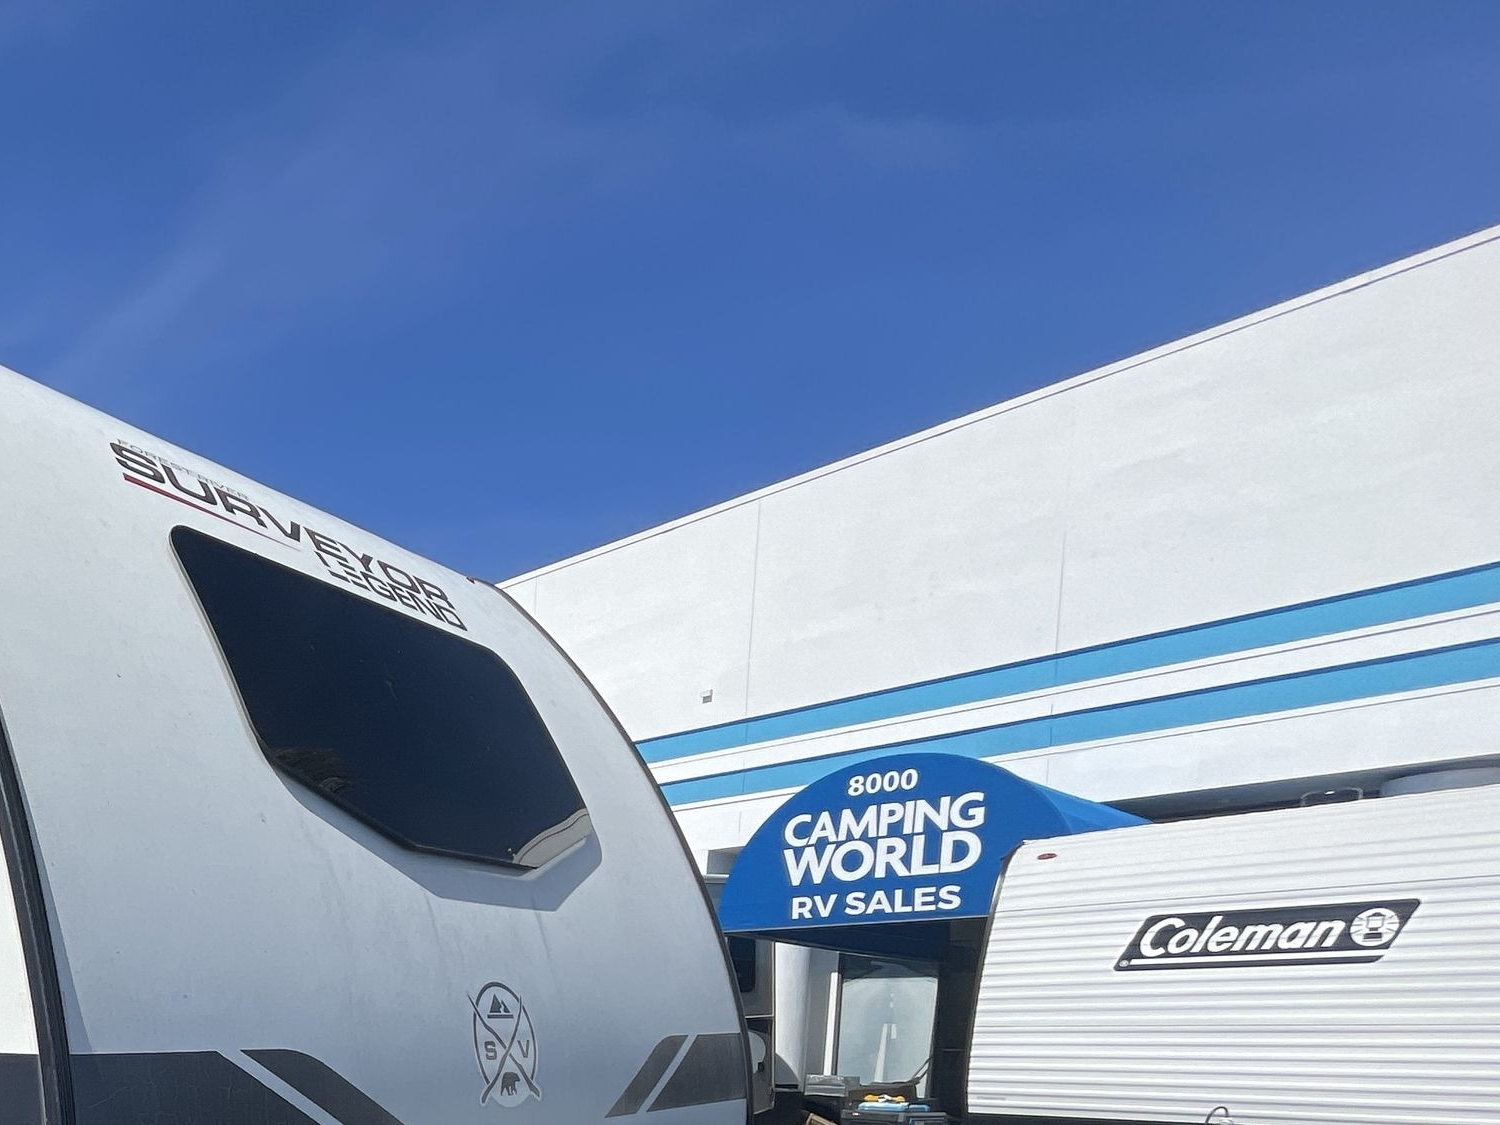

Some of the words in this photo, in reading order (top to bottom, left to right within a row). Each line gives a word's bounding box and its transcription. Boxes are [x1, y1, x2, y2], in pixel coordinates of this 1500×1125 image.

[109, 442, 455, 610] SURVEYOR
[315, 551, 468, 631] LEGEND
[847, 768, 919, 797] 8000
[783, 791, 986, 848] CAMPING
[783, 830, 983, 887] WORLD
[791, 893, 838, 920] RV
[844, 885, 962, 916] SALES
[1138, 915, 1347, 958] Coleman
